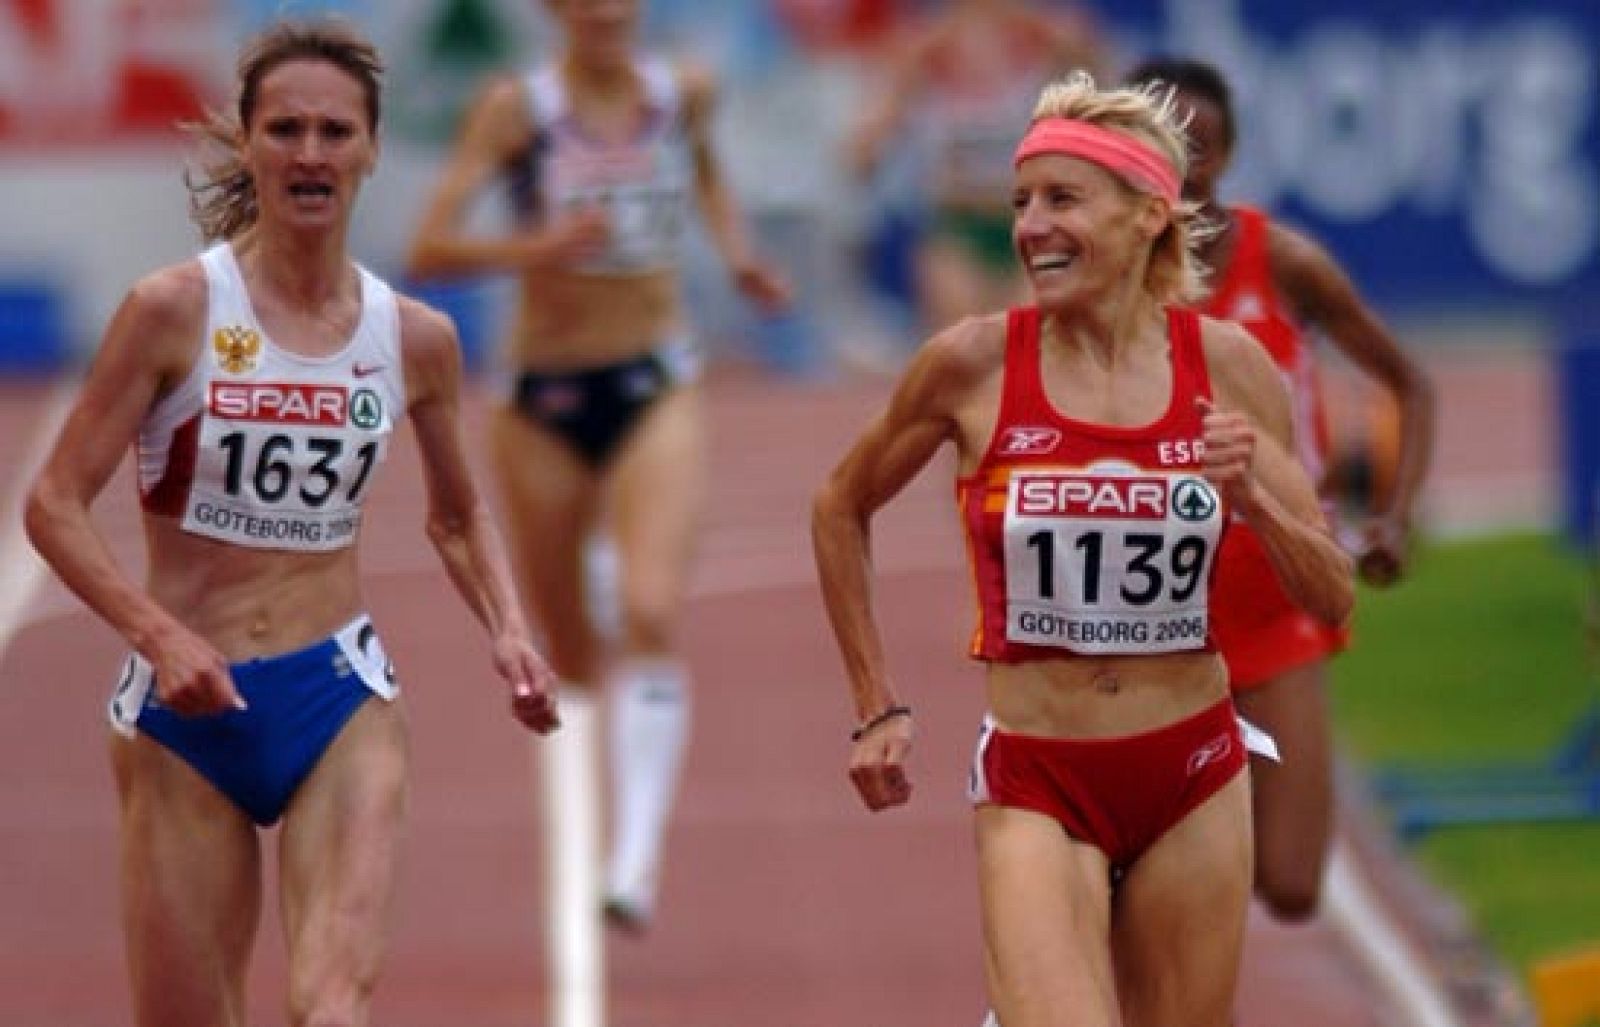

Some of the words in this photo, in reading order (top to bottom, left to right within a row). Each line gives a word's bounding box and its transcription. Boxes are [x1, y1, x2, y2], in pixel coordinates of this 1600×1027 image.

[214, 388, 344, 421] SPAR
[219, 430, 379, 507] 1631
[1021, 480, 1166, 514] SPAR
[1026, 528, 1208, 606] 1139
[1154, 615, 1204, 643] 2006
